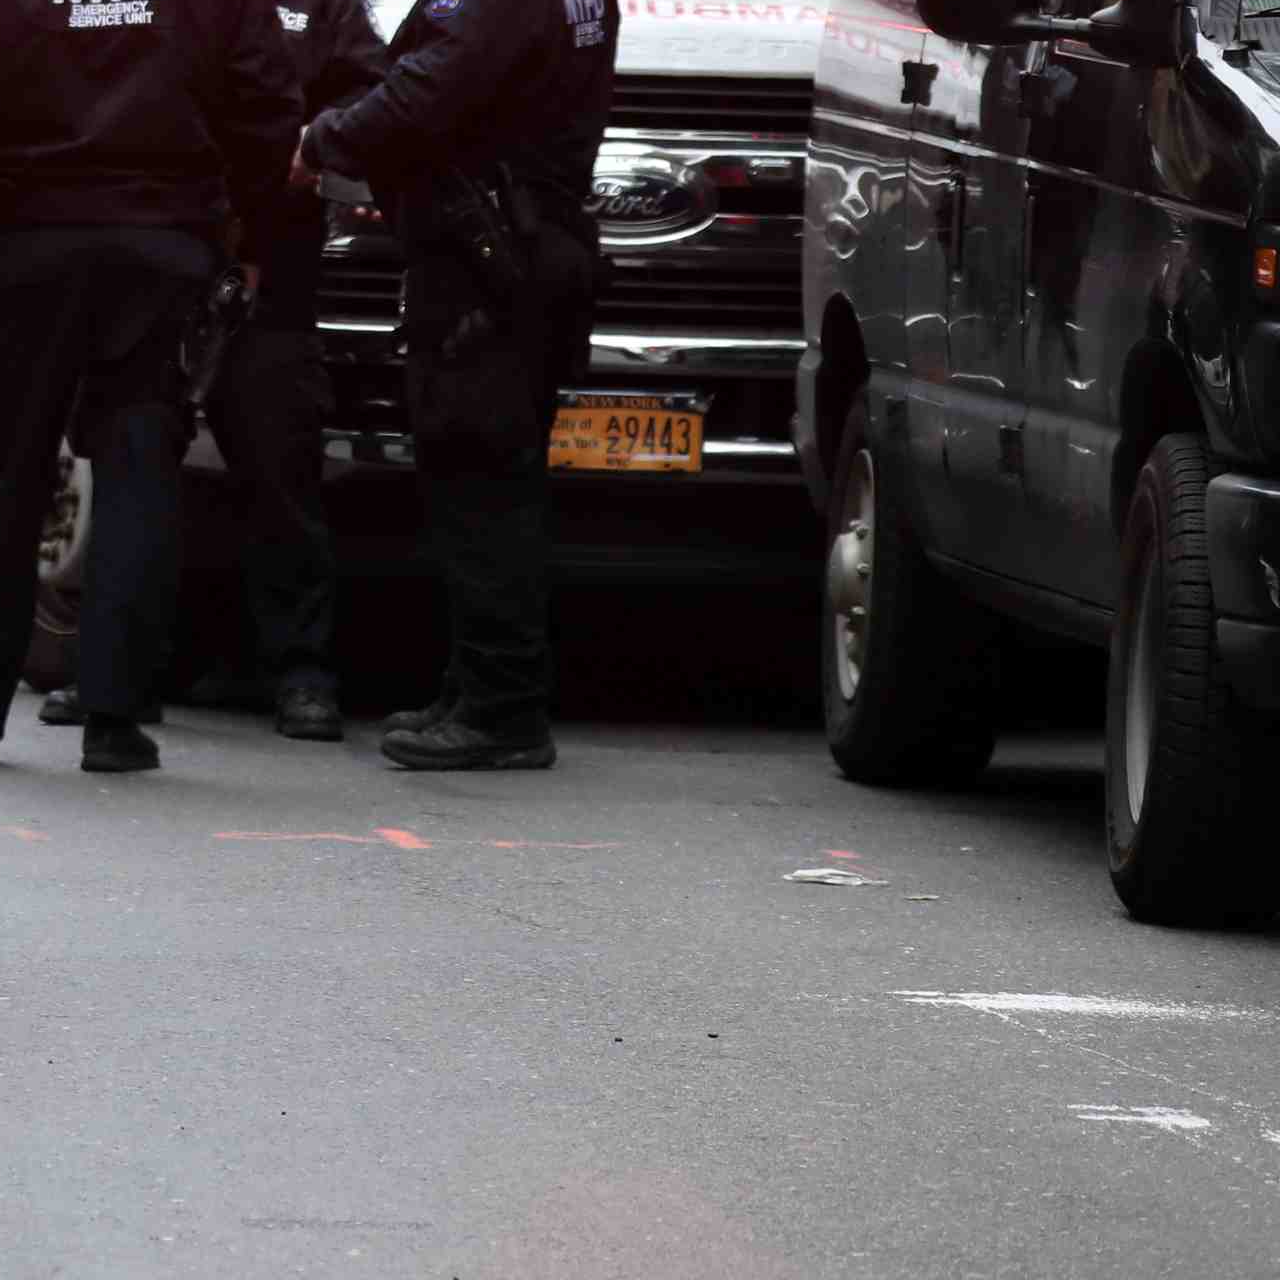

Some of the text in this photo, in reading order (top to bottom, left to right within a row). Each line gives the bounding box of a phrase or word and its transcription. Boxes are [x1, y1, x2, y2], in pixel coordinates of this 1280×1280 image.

[71, 0, 149, 17] EMERGENCY
[68, 11, 154, 28] SERVICE UNIT
[582, 189, 668, 215] Ford
